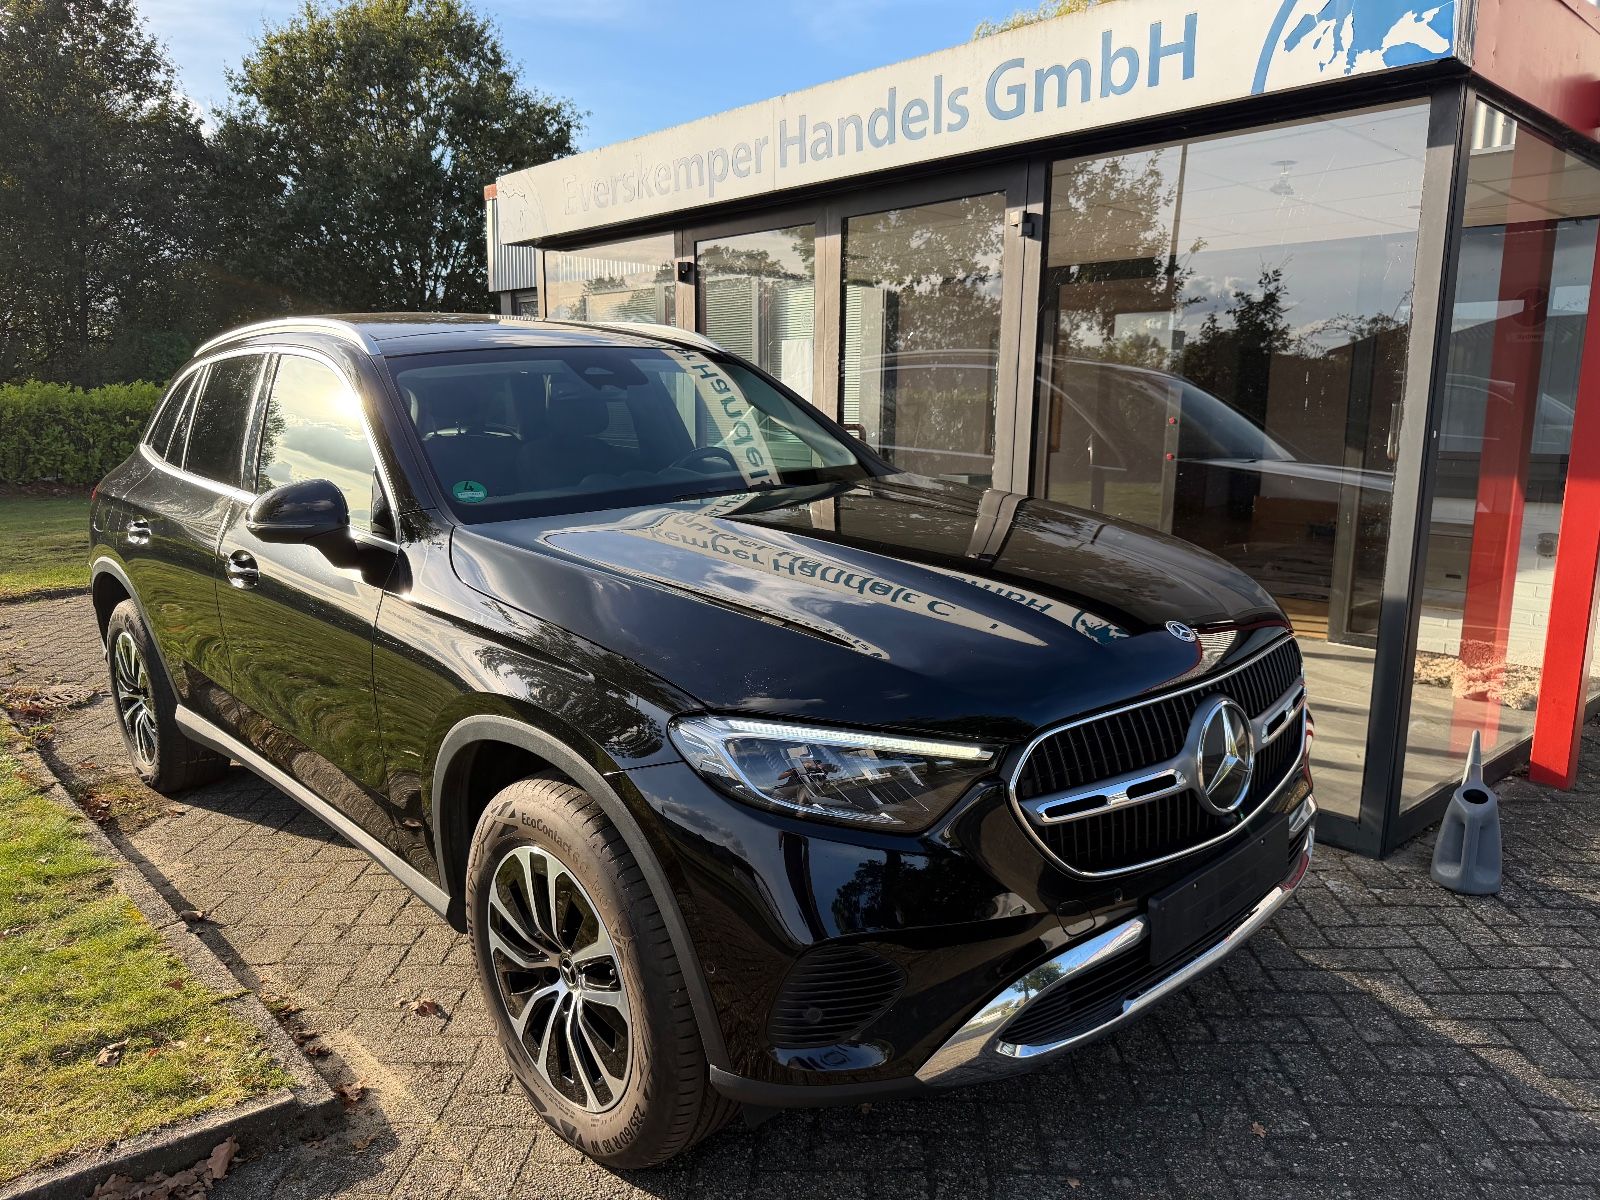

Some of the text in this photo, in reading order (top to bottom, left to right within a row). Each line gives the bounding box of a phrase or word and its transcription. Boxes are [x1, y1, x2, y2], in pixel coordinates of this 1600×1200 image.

[562, 13, 1198, 215] Everskemper Handels GmbH
[464, 481, 474, 491] 4
[521, 811, 573, 856] EcoContact
